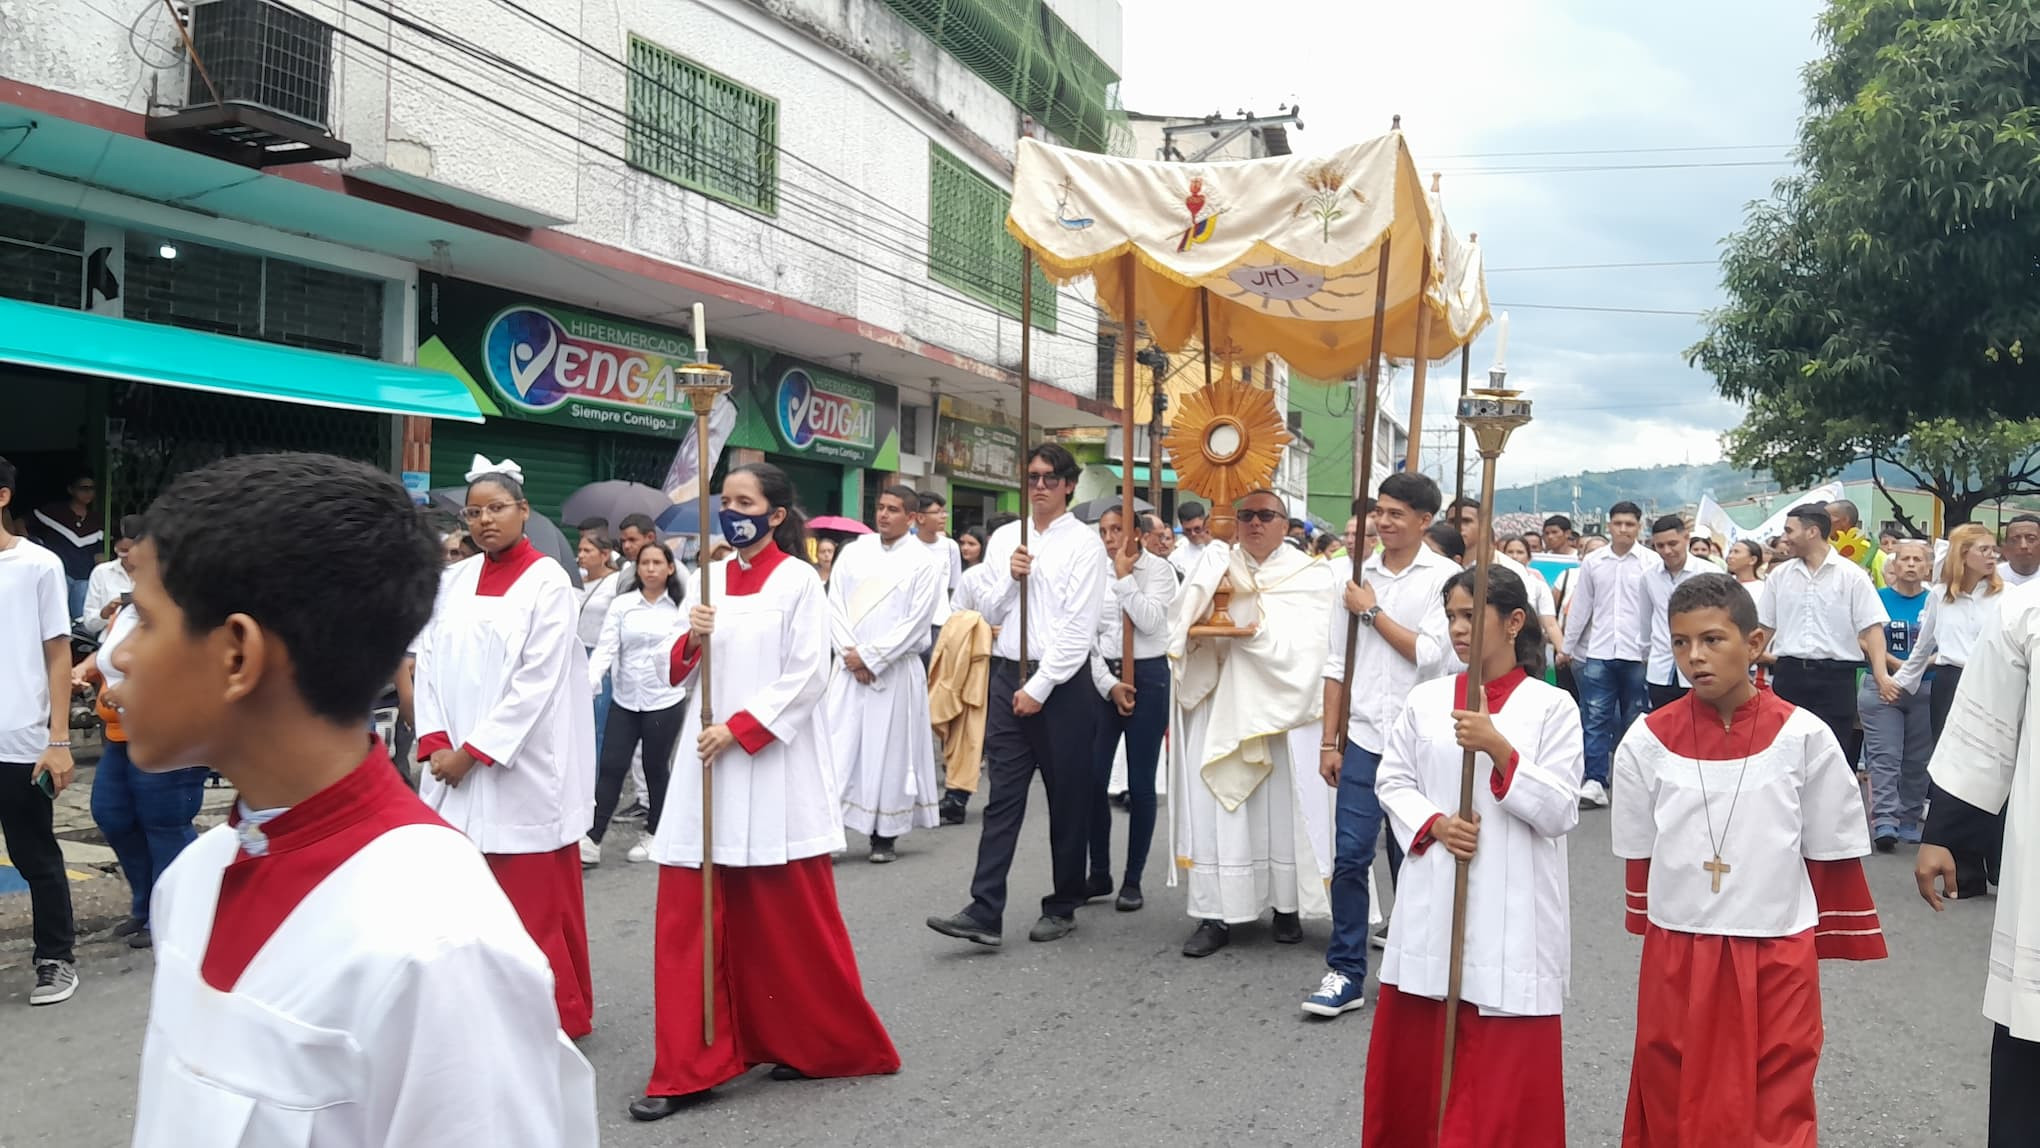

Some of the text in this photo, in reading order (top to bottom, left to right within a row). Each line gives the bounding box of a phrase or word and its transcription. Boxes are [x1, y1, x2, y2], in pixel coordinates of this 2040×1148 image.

[571, 320, 689, 357] HIPERMERCADO
[509, 320, 686, 404] VENGA
[571, 404, 620, 423] Siempre
